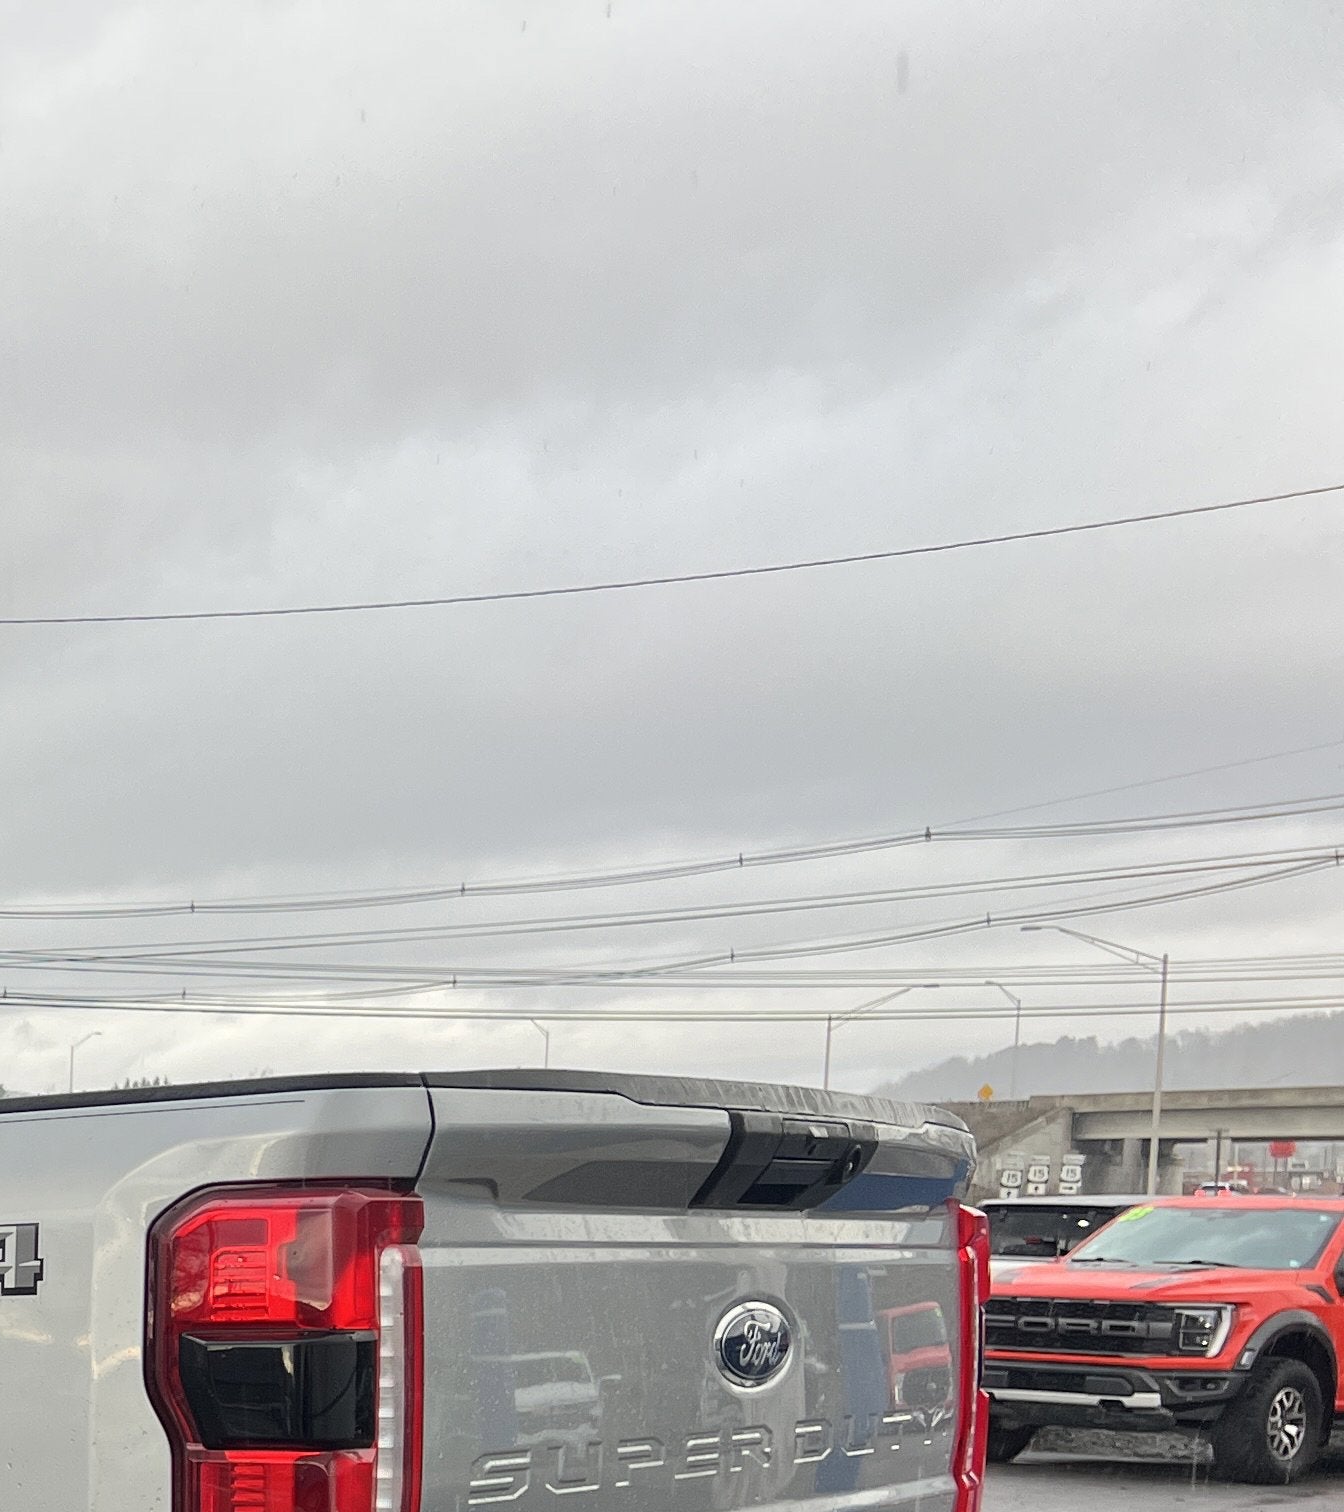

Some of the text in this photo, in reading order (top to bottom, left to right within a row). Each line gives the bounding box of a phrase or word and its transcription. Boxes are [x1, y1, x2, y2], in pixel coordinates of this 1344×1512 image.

[739, 1319, 785, 1367] Ford
[469, 1406, 954, 1505] SUPER DUTY
